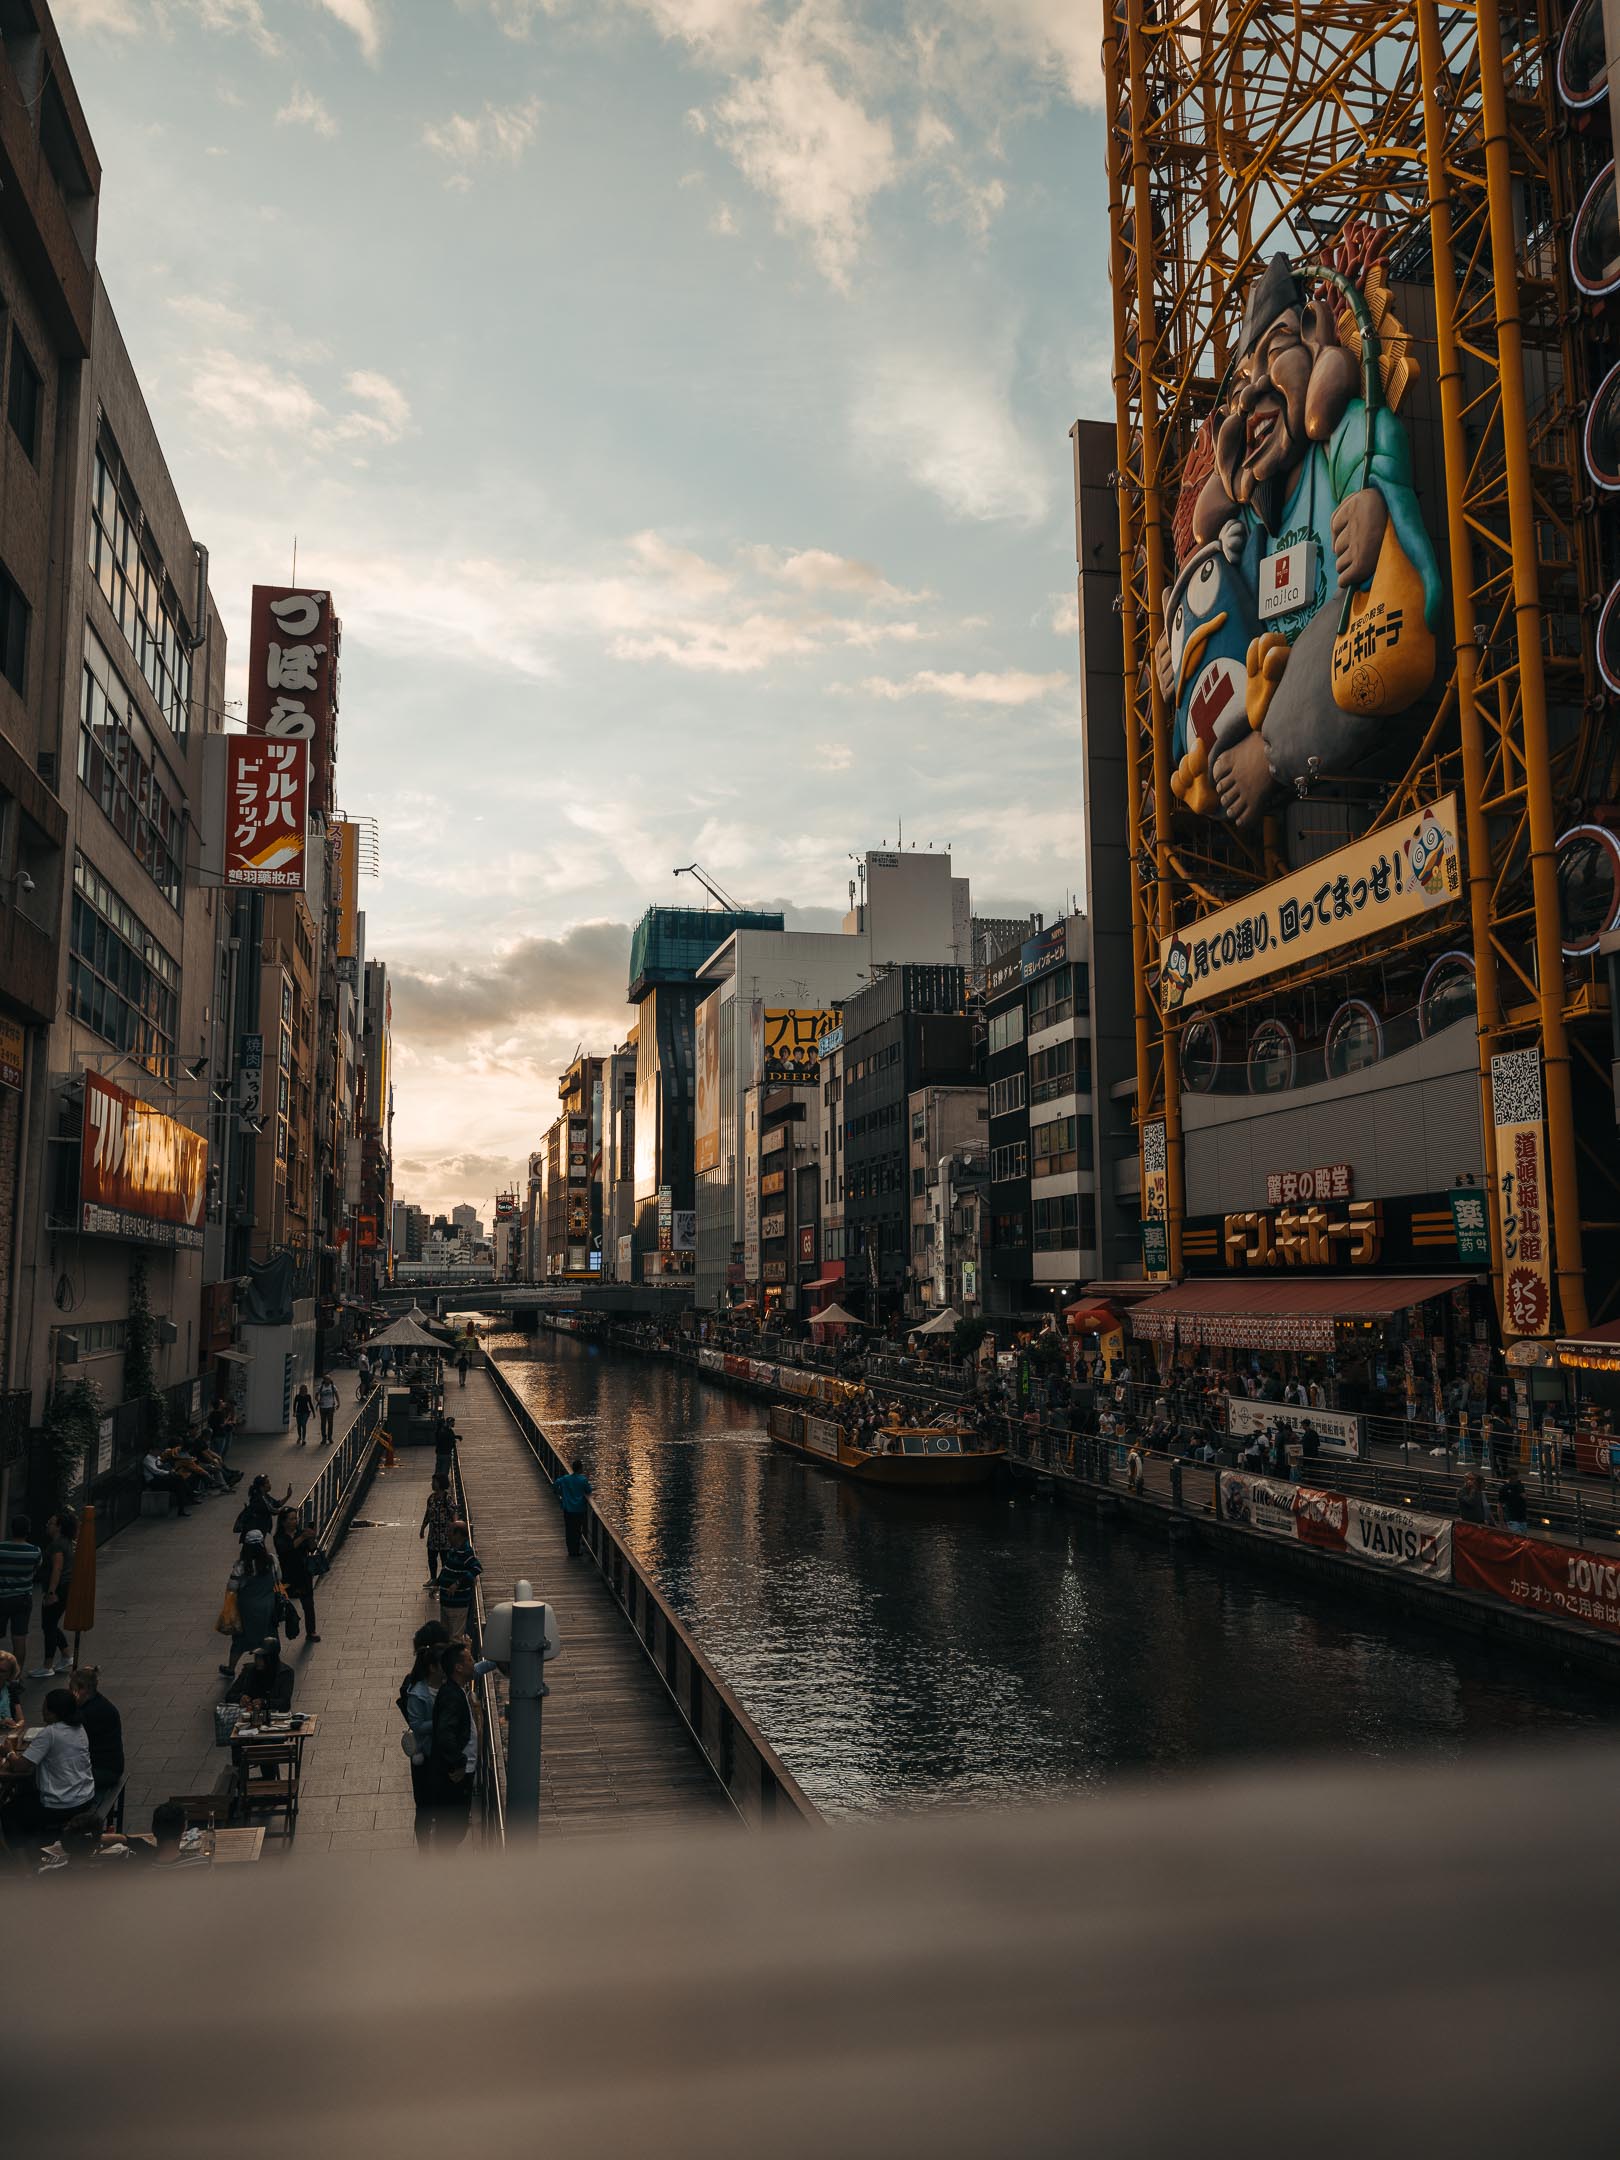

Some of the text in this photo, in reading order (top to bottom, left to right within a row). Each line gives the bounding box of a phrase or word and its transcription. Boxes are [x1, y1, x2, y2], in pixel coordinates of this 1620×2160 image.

[265, 592, 327, 782] づぼら
[234, 757, 263, 848] ドラッグ
[265, 744, 298, 828] ツルハ
[246, 1038, 262, 1067] 焼肉
[769, 1072, 811, 1081] DEEP
[1267, 1165, 1350, 1204] 驚安の殿堂
[1515, 1132, 1542, 1262] 道頓堀北館
[1144, 1227, 1165, 1248] 薬
[1453, 1199, 1485, 1230] 薬
[1501, 1172, 1518, 1260] オープン
[1359, 1518, 1417, 1561] VANS
[1510, 1578, 1620, 1627] カラオケのご用命は
